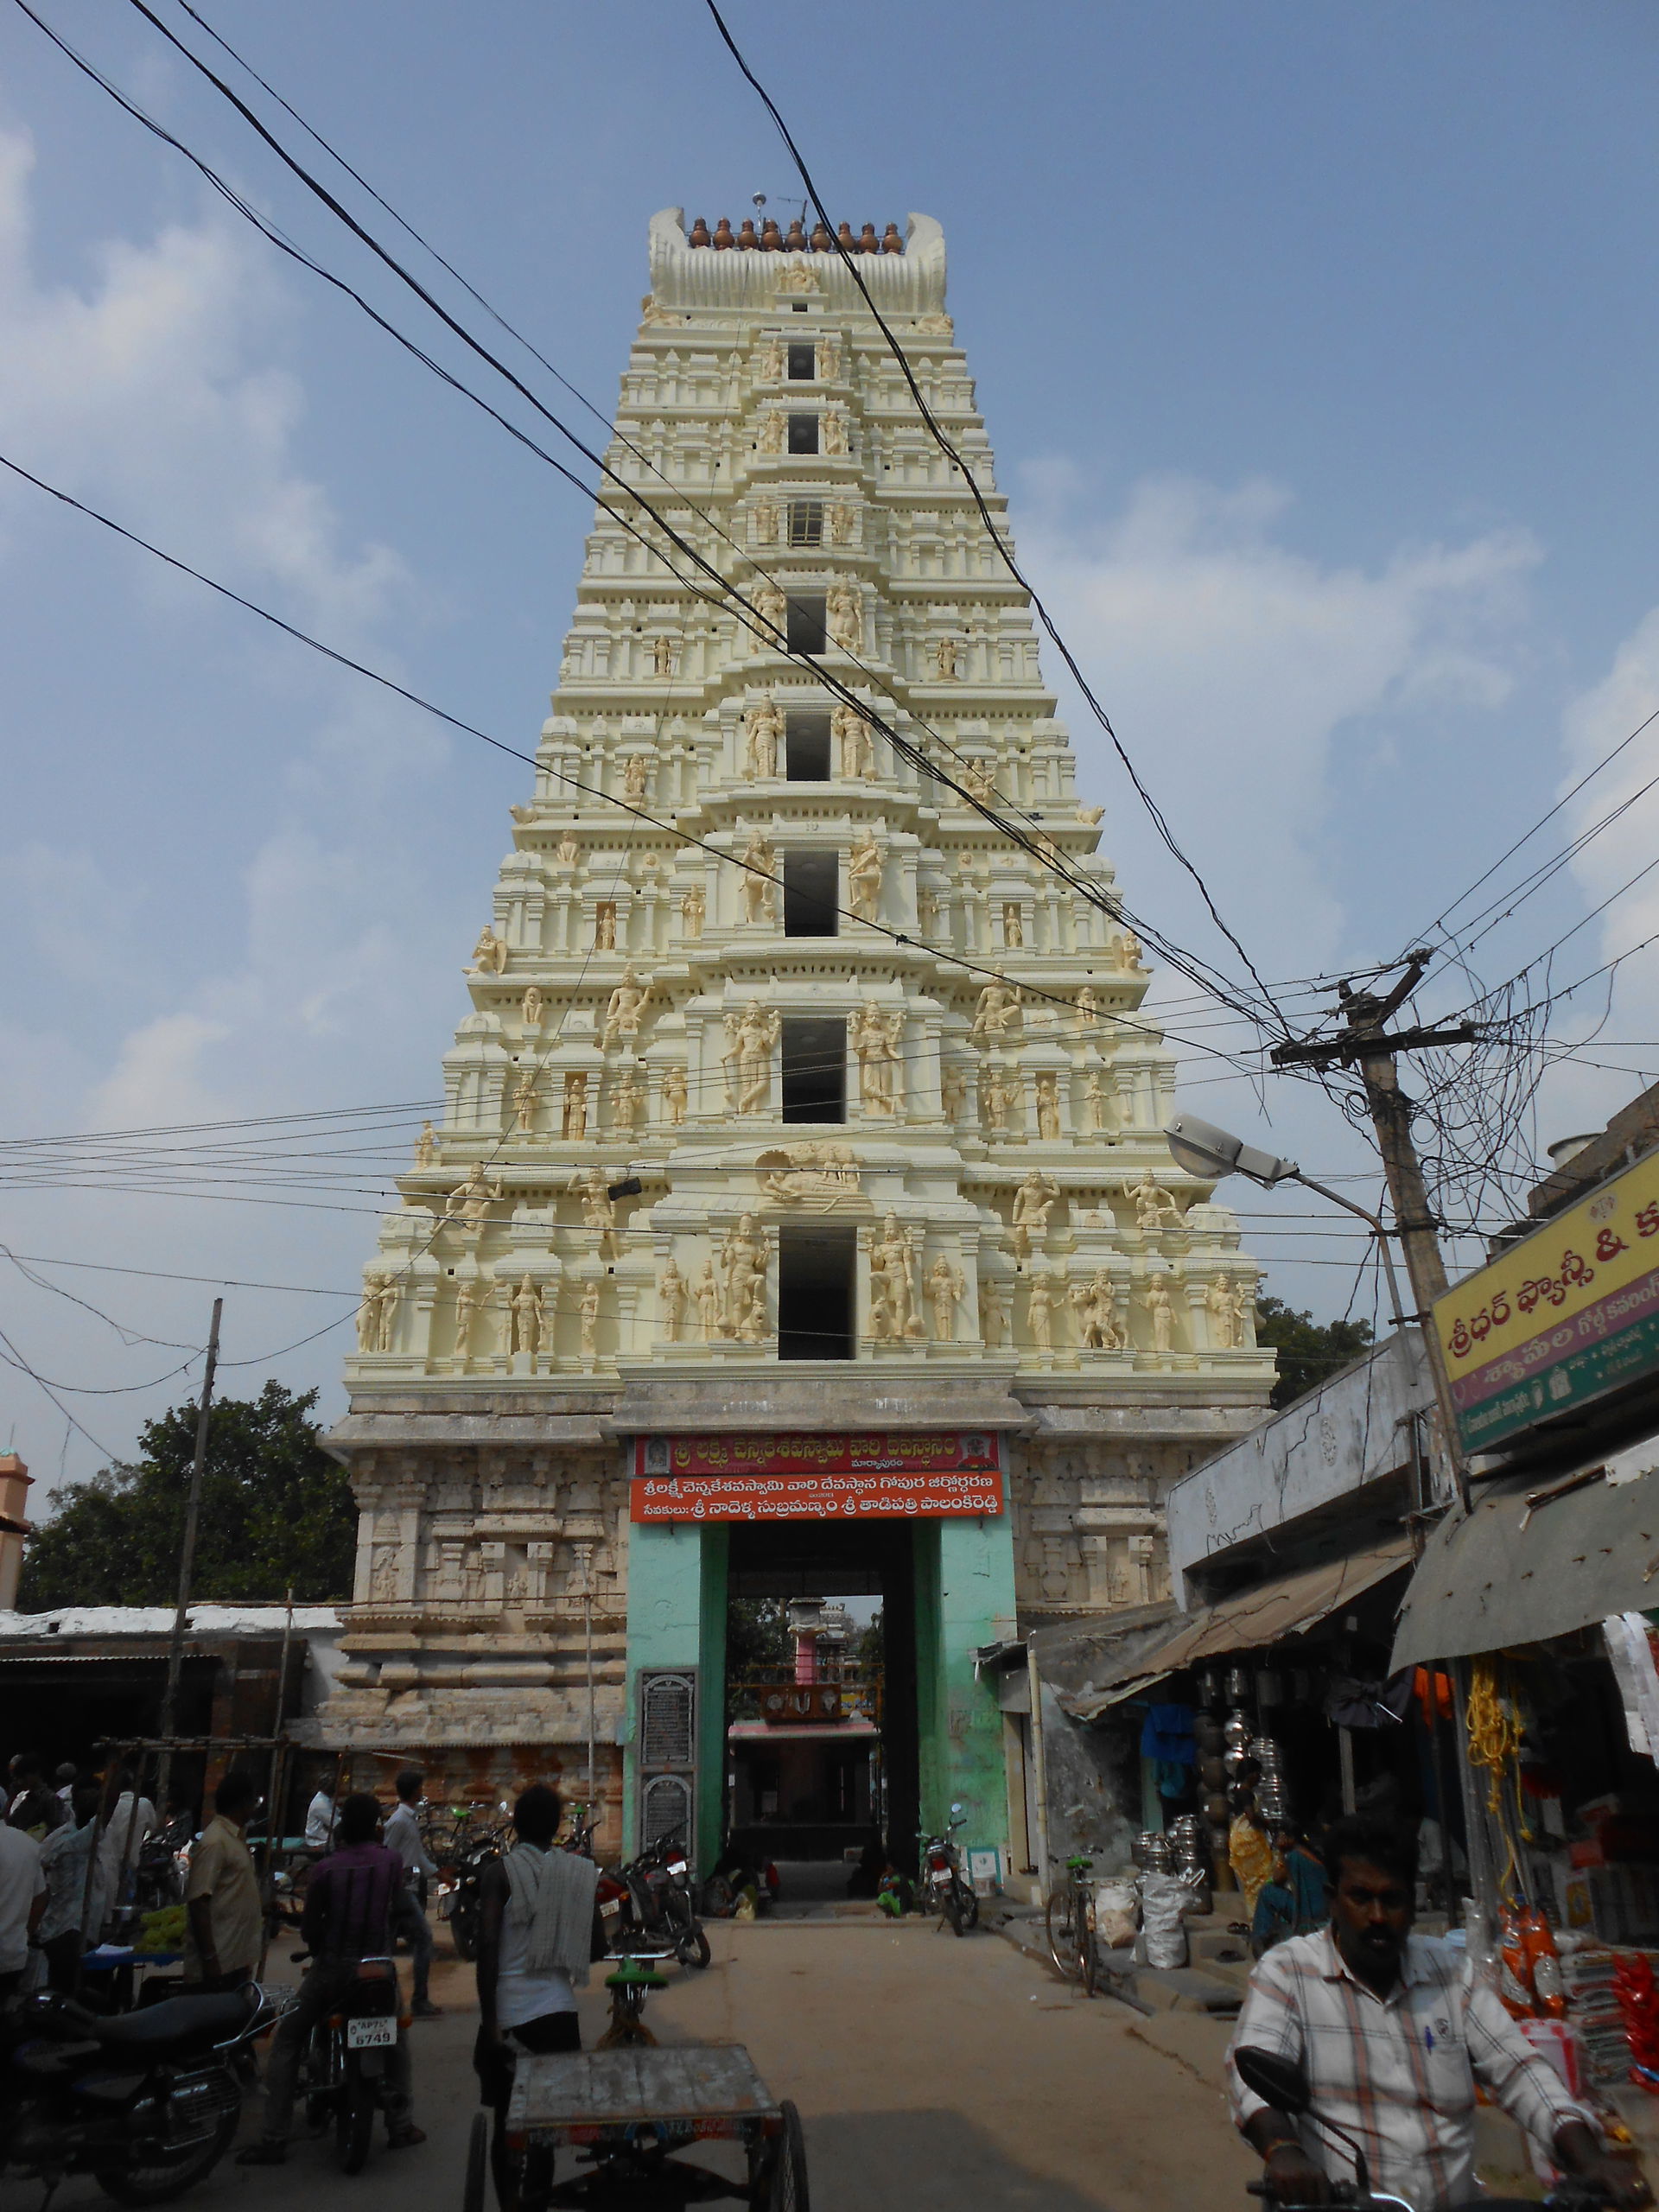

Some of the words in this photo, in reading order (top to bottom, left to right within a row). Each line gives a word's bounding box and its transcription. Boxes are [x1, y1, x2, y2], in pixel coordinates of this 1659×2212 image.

[1448, 1290, 1510, 1358] శ్రీధర్
[1596, 1228, 1630, 1262] &
[787, 1479, 817, 1491] వారి
[880, 1476, 925, 1491] గోపుర
[690, 1498, 706, 1518] శ్రీ
[841, 1496, 856, 1516] శ్రీ
[356, 2032, 390, 2045] 6749
